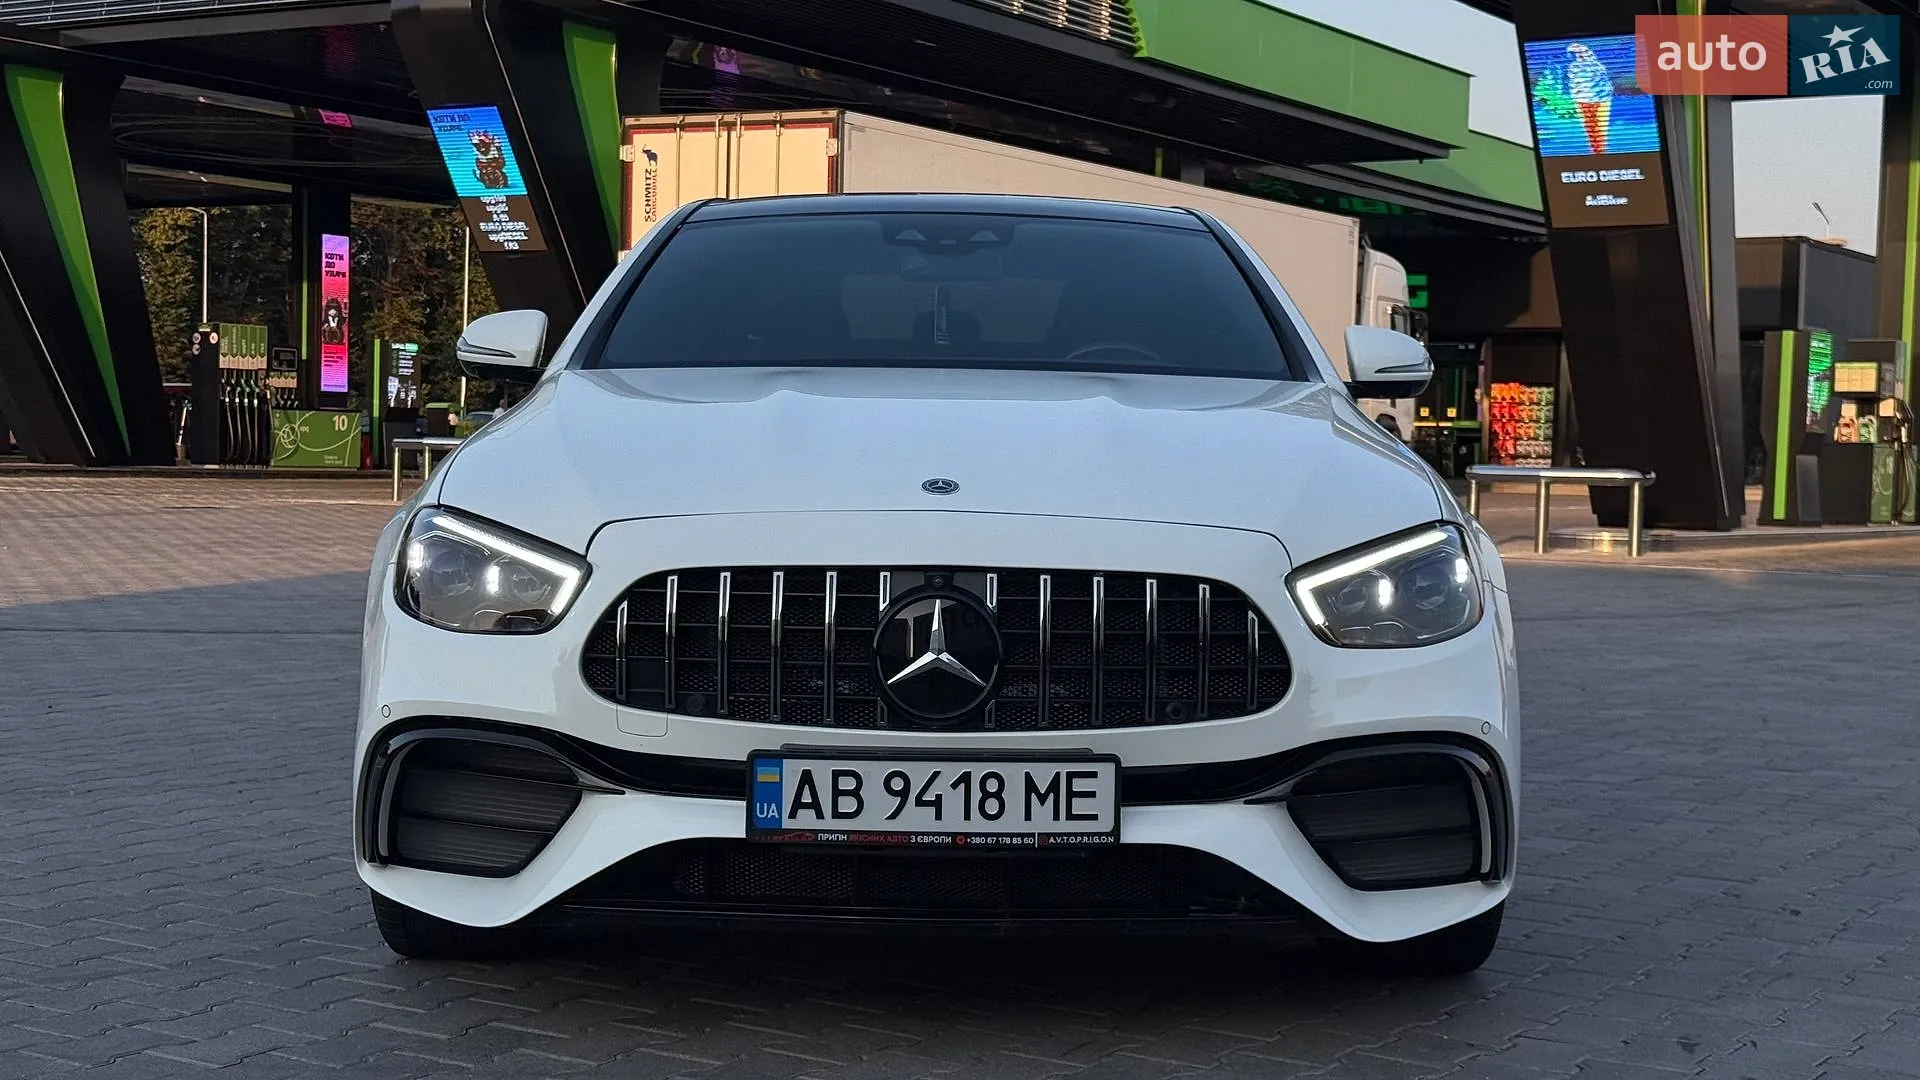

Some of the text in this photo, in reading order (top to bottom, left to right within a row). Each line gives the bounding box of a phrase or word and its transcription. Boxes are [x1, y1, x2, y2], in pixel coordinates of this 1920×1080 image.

[1561, 168, 1645, 183] EURO DIESEL
[644, 168, 652, 222] SCHMITZ
[325, 252, 344, 261] КОТИ
[332, 415, 348, 431] 10
[787, 768, 1099, 821] AB 9418 ME
[756, 803, 778, 819] UA
